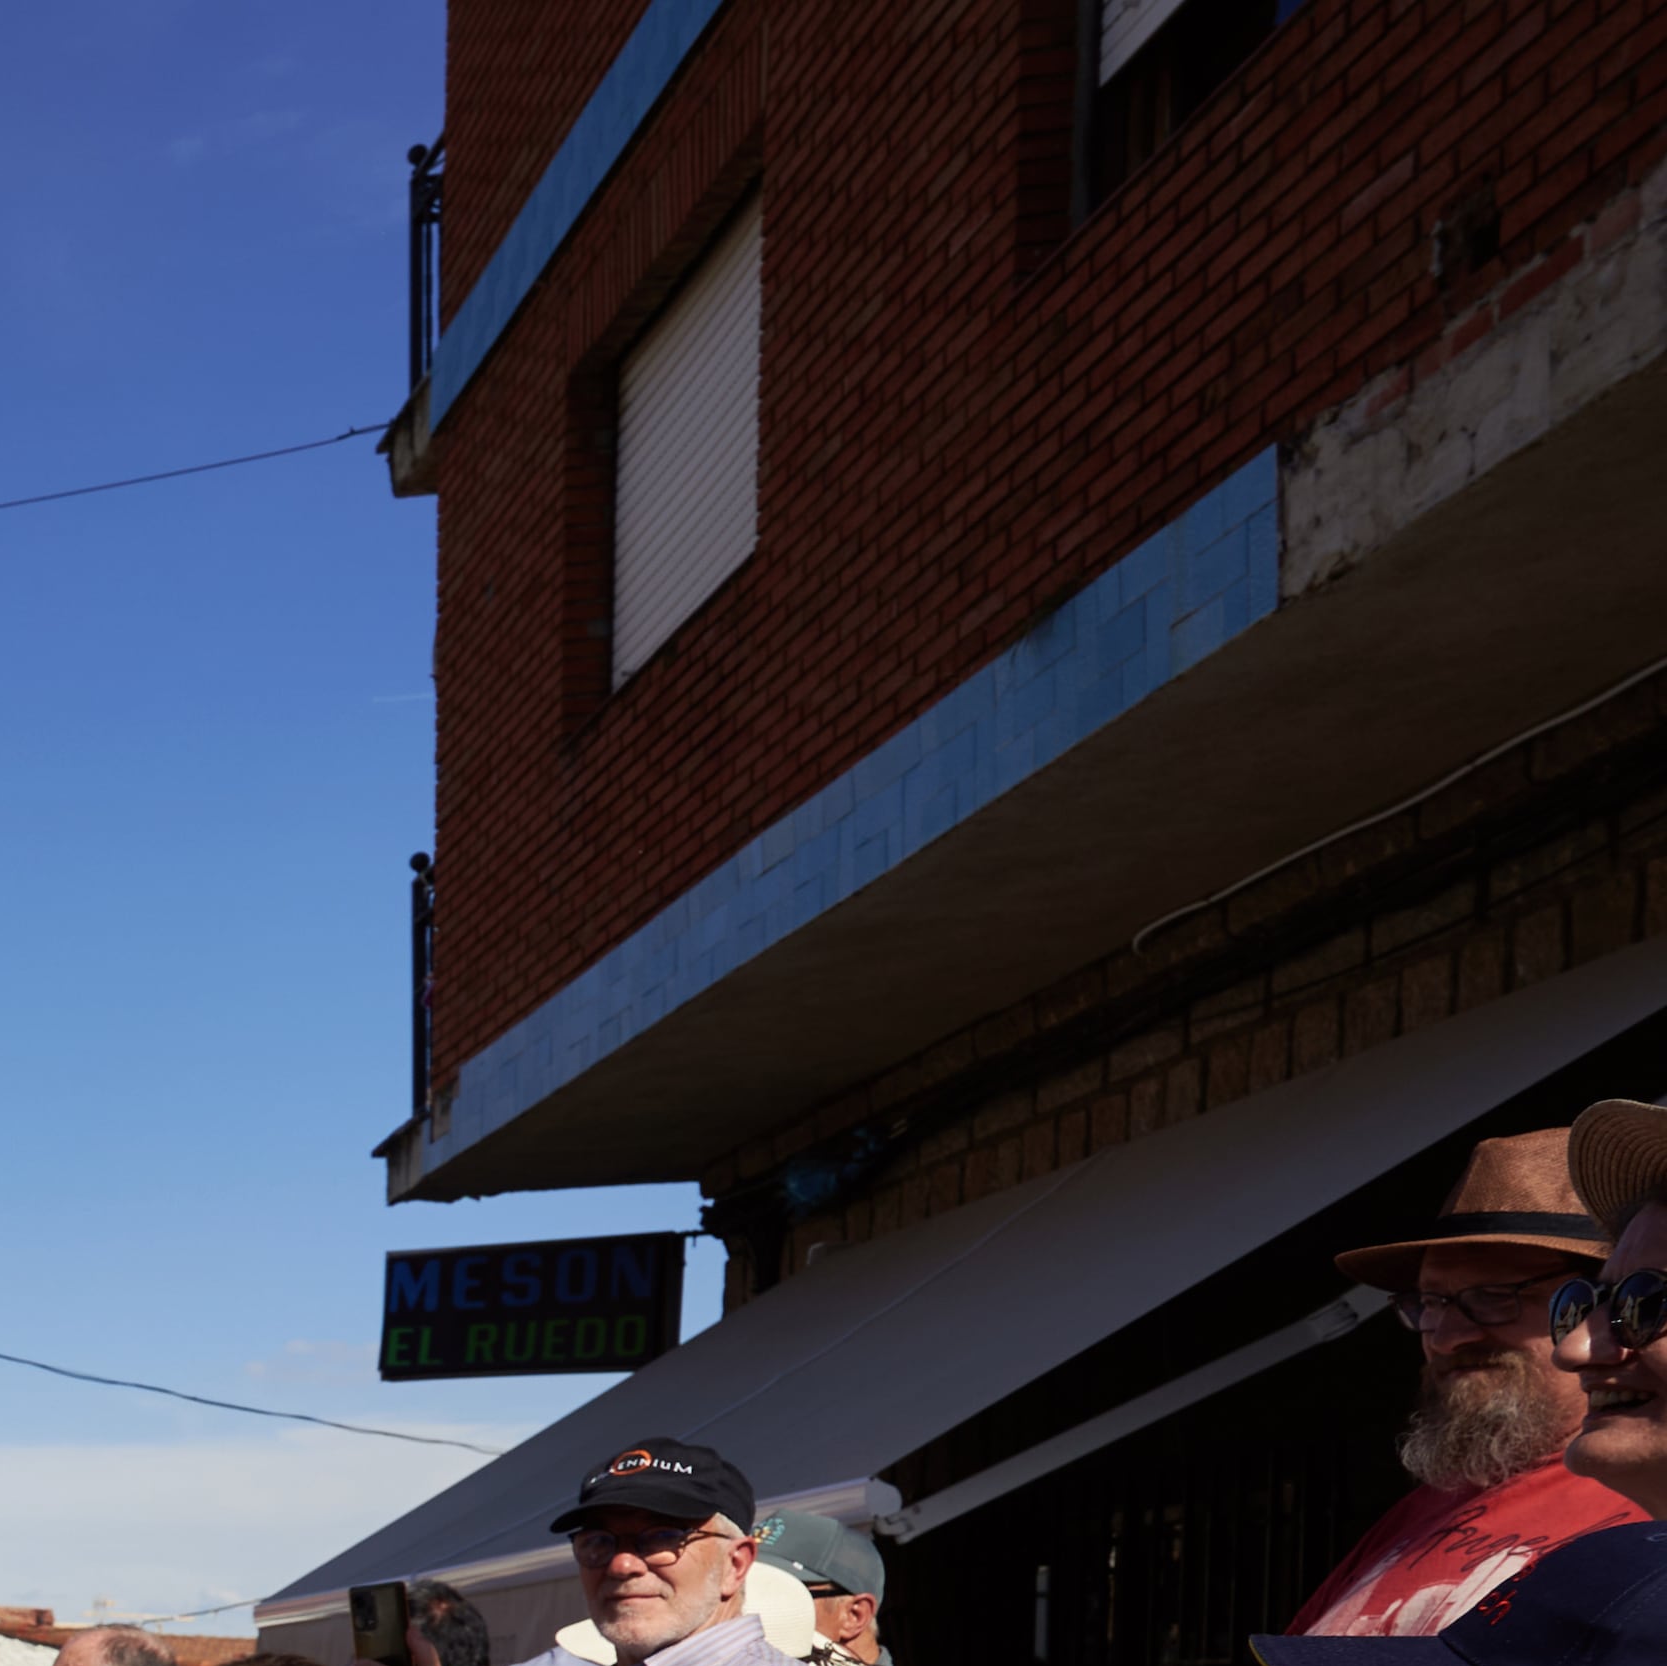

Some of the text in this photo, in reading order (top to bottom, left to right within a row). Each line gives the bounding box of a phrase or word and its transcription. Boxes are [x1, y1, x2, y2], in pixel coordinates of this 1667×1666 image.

[388, 1246, 654, 1313] MESON
[386, 1314, 648, 1367] EL RUEDO
